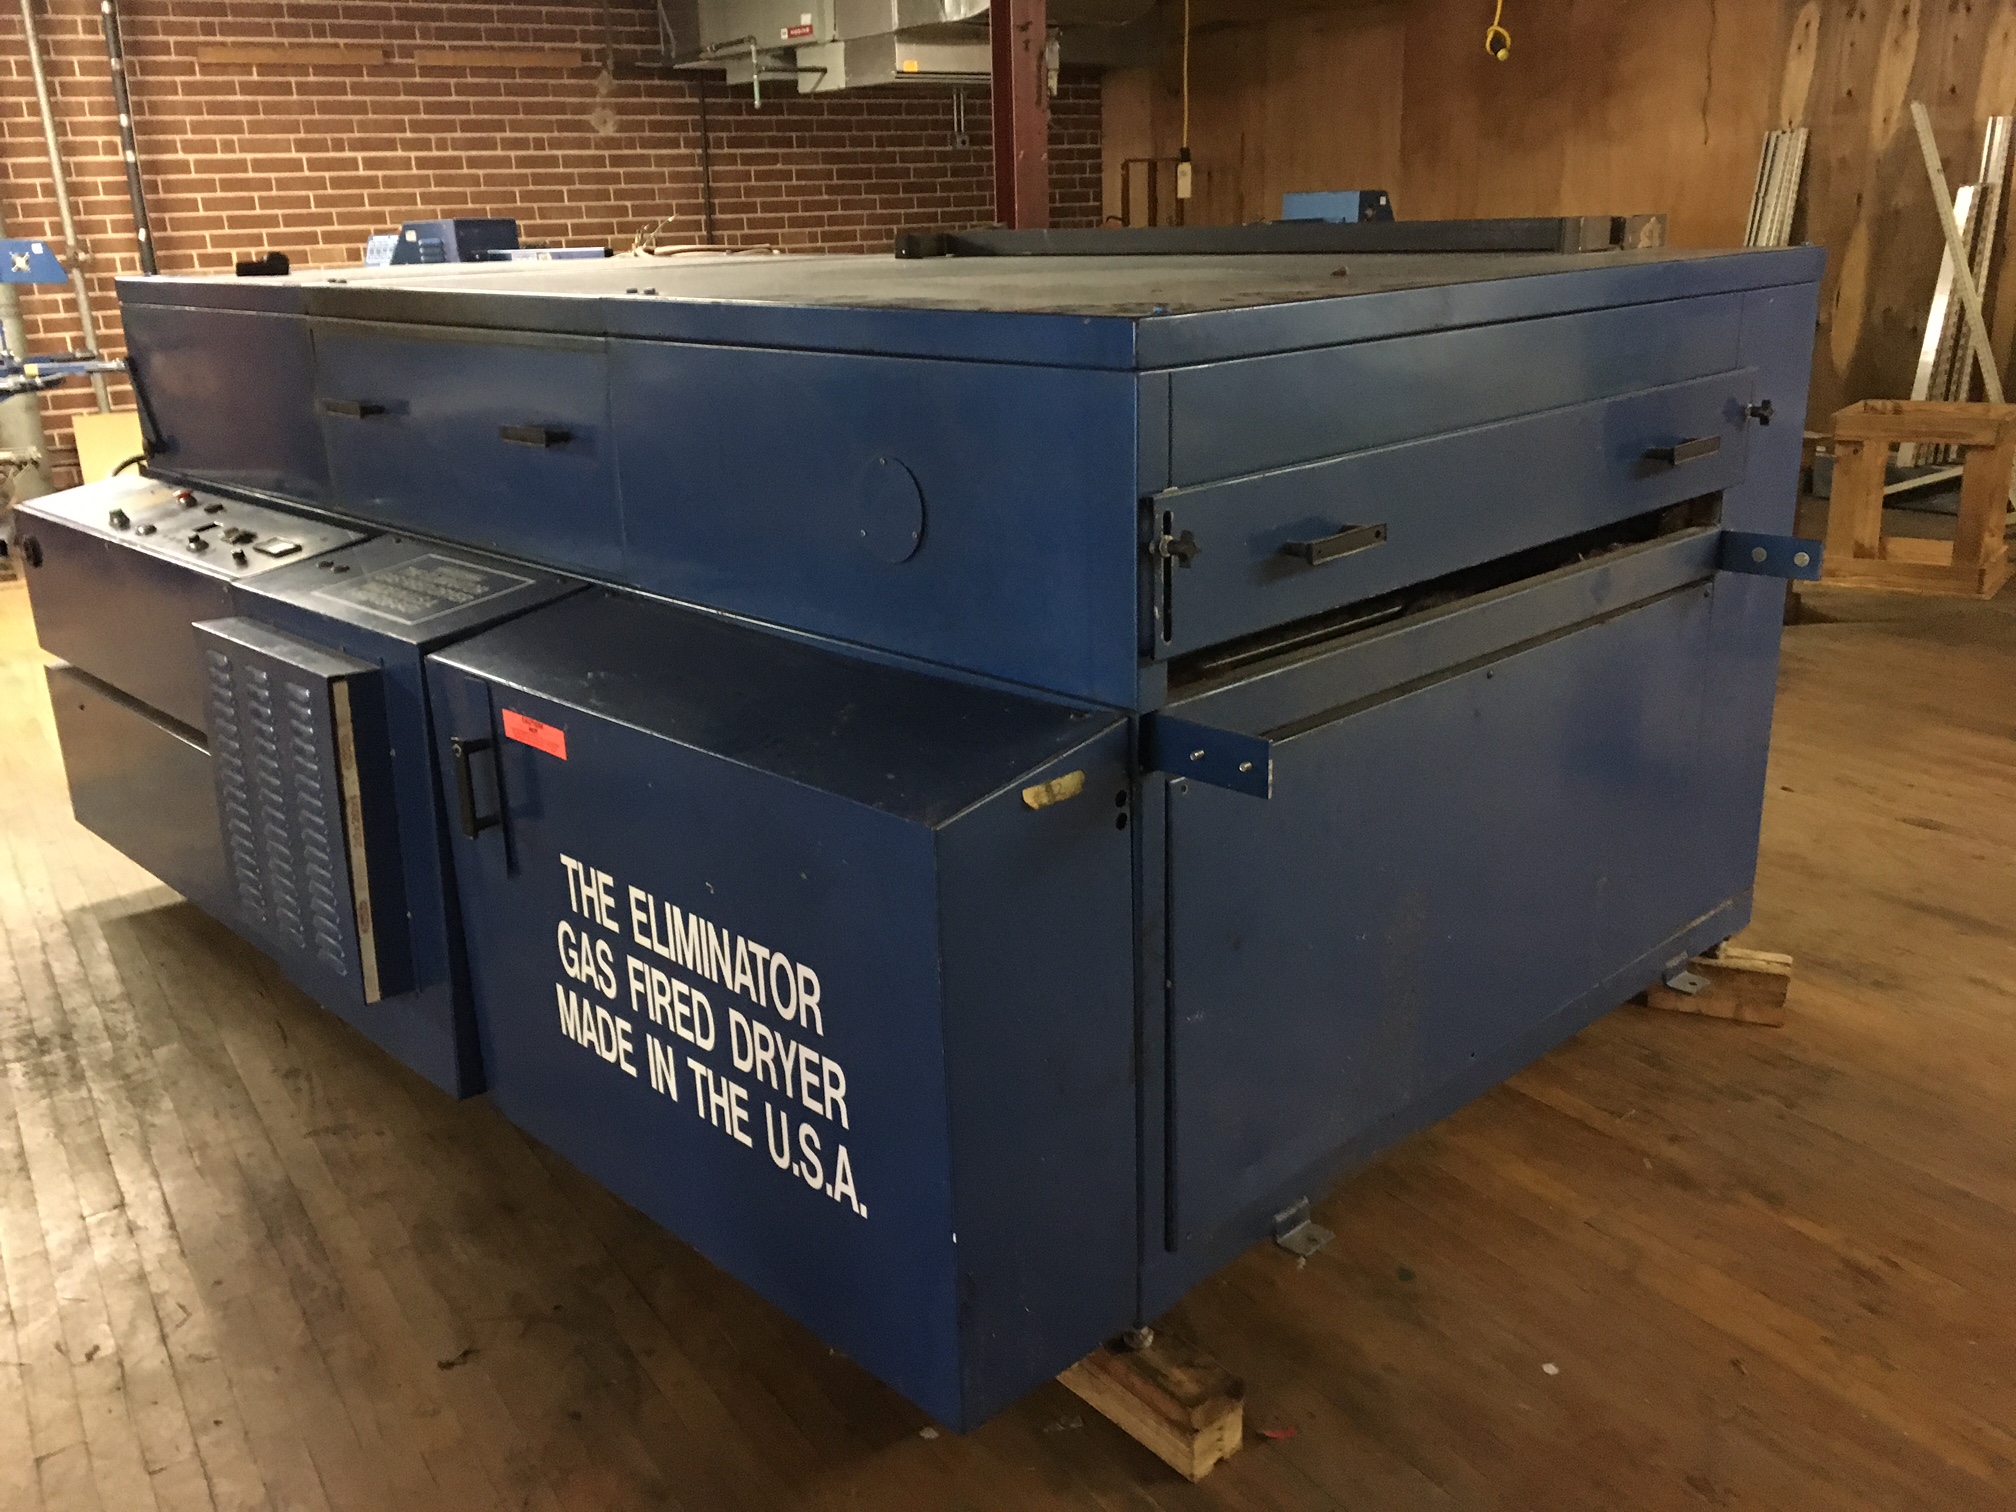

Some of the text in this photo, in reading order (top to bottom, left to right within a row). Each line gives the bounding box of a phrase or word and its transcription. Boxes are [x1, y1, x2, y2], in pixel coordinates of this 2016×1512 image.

[557, 920, 850, 1130] GAS FIRED DRYER
[559, 852, 824, 1037] THE ELIMINATOR
[555, 982, 868, 1220] MADE IN THE U.S.A.
